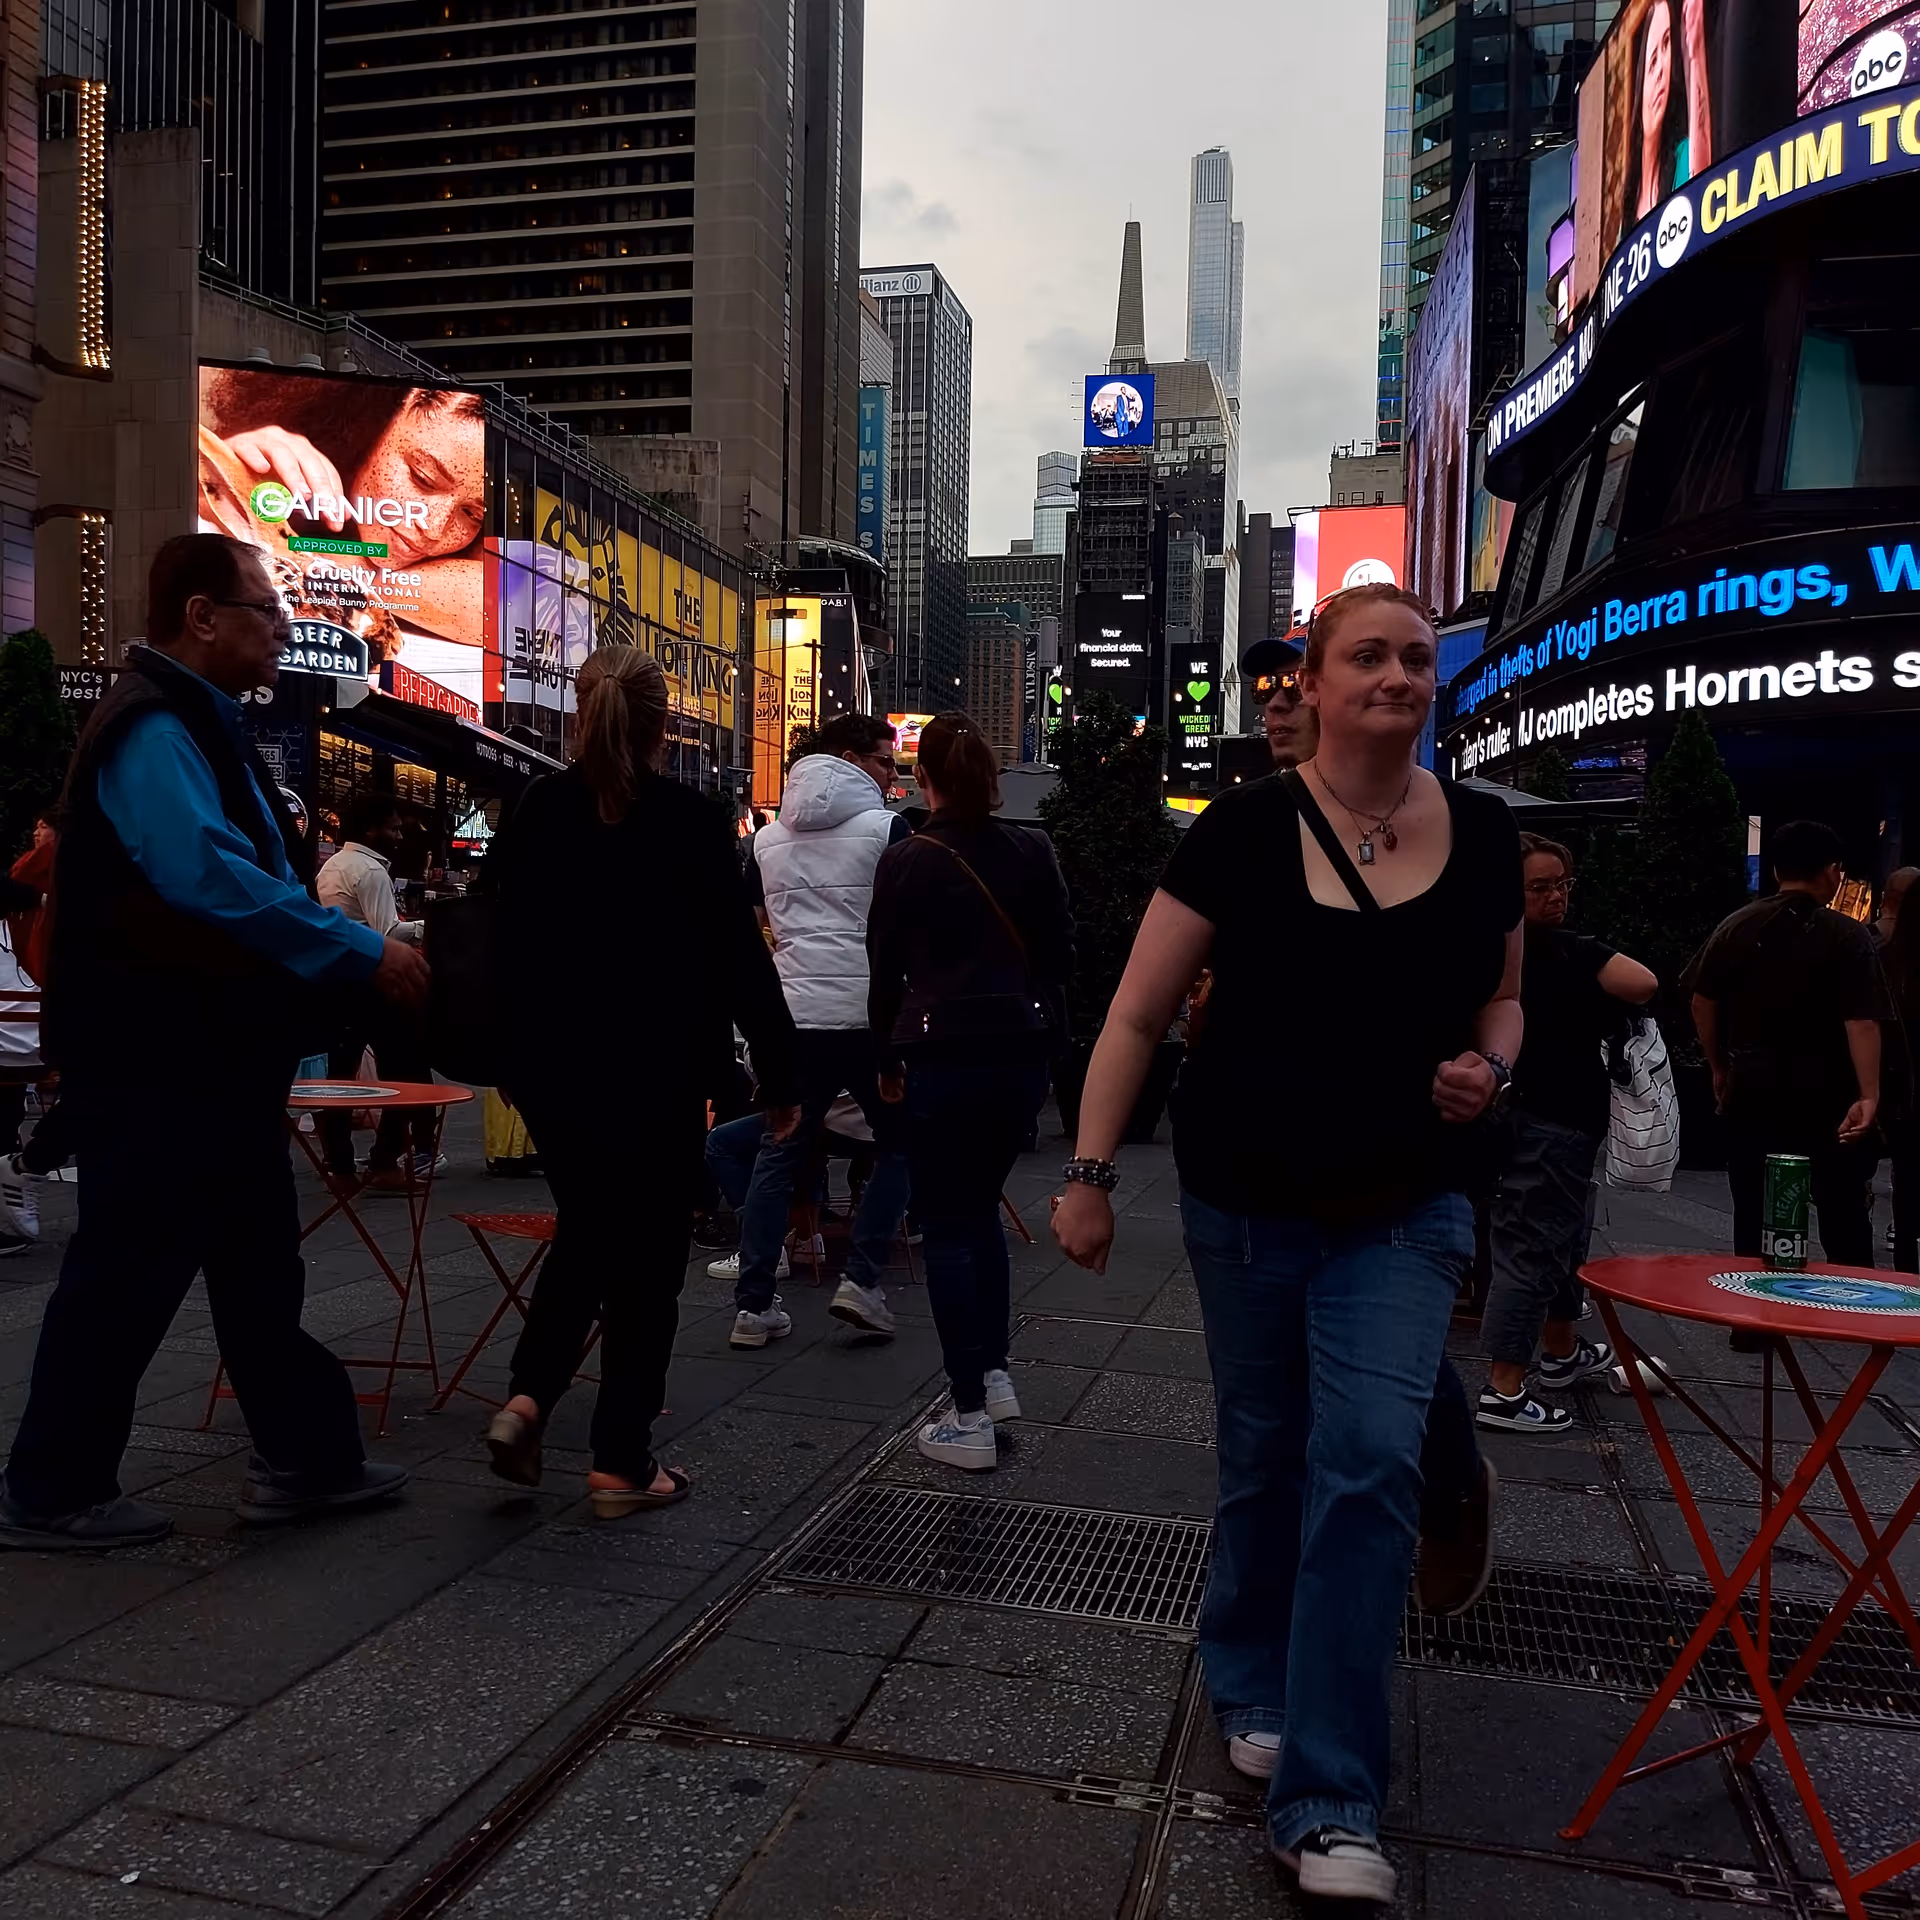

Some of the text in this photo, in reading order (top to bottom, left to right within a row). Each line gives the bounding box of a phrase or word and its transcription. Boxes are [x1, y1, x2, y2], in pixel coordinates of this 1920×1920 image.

[1855, 51, 1902, 91] abc
[861, 277, 899, 293] llianz
[1505, 345, 1575, 440] PREMIERE
[1578, 307, 1597, 375] MO
[1627, 232, 1650, 294] 26
[1659, 215, 1688, 248] abc
[1700, 122, 1843, 235] CLAIM
[859, 403, 877, 513] TIMES
[293, 539, 383, 555] APPROVED BY
[307, 560, 421, 586] Cruelty Free
[308, 581, 421, 598] INTERNATIONAL
[302, 595, 336, 607] Leaping
[340, 597, 367, 609] Bunny
[369, 599, 419, 611] Programme
[673, 588, 700, 626] THE
[1488, 663, 1498, 696] in
[1500, 644, 1534, 689] thefts
[1538, 628, 1552, 669] of
[1555, 607, 1597, 660] Yogi
[1604, 599, 1687, 642] Berra
[1698, 568, 1848, 616] rings,
[1867, 544, 1920, 592] W
[294, 627, 343, 649] BEER
[1101, 628, 1122, 637] Your
[1080, 643, 1119, 652] financial
[279, 647, 358, 673] GARDEN
[1091, 658, 1131, 667] Secured.
[1190, 662, 1208, 674] WE
[60, 671, 103, 684] NYC's
[794, 676, 813, 684] THE
[60, 685, 102, 700] best
[787, 704, 812, 721] KIN
[1486, 721, 1511, 761] rule:
[1536, 684, 1654, 740] completes
[1665, 650, 1874, 711] Hornets
[1892, 652, 1920, 688] s
[1185, 724, 1210, 733] GREEN
[1185, 736, 1209, 748] NYC
